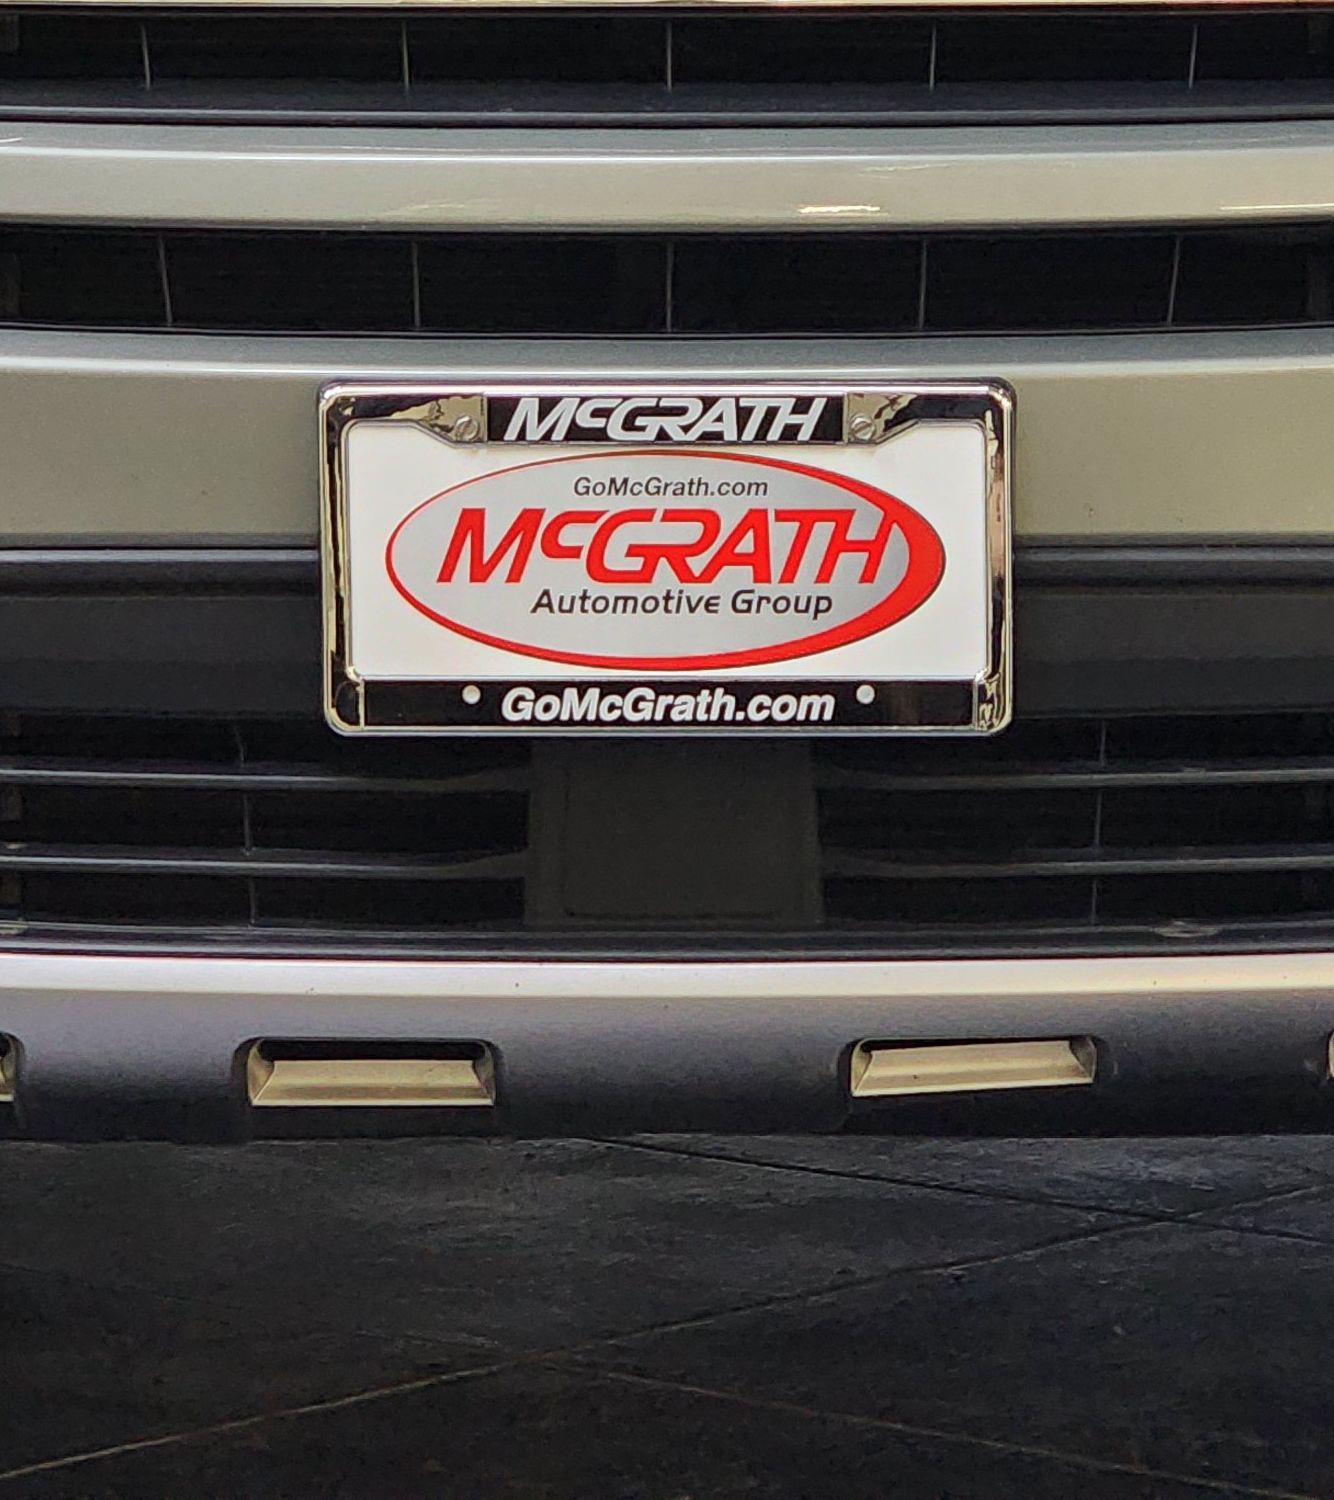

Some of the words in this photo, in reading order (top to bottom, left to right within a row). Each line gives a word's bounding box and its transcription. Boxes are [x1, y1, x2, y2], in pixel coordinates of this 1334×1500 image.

[573, 476, 768, 497] GoMcGrath.com
[530, 589, 721, 615] Automotive
[731, 589, 833, 620] Group
[501, 687, 835, 722] GoMcGrath.com
